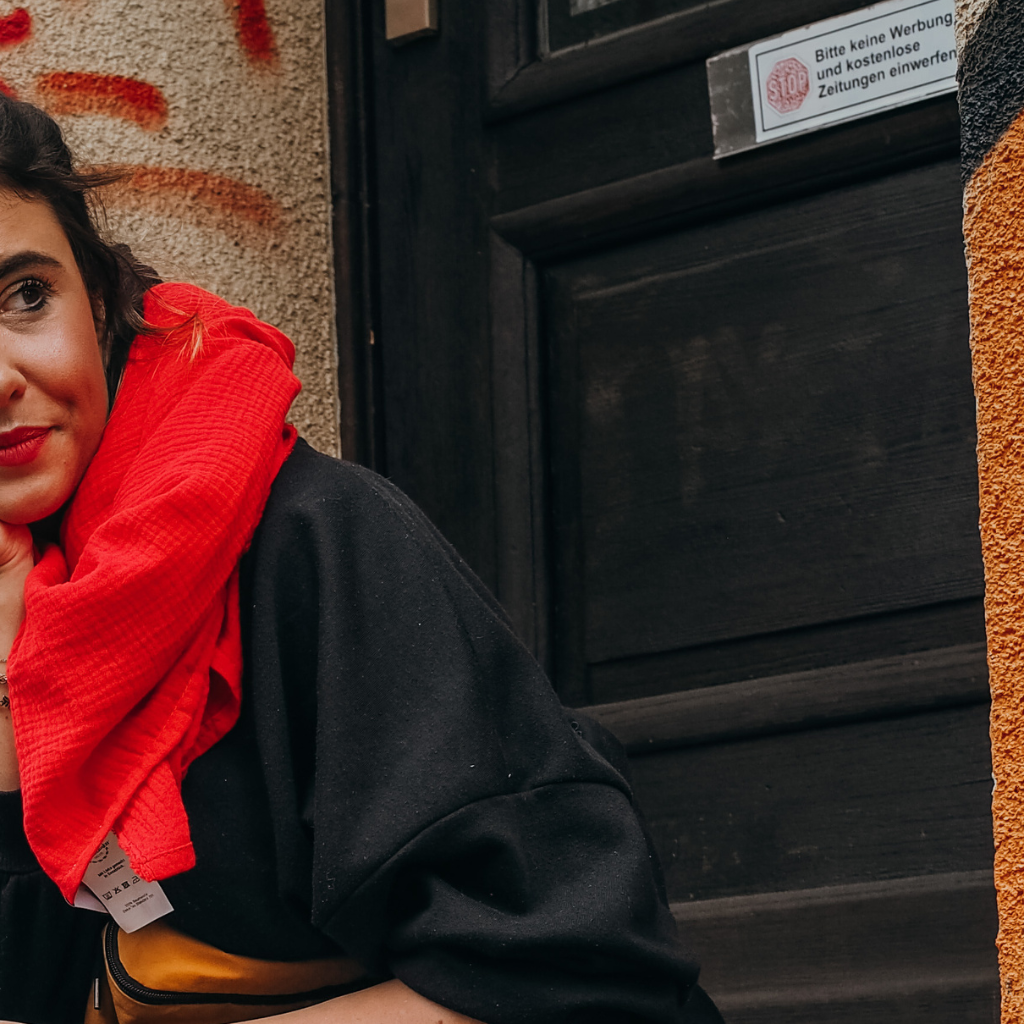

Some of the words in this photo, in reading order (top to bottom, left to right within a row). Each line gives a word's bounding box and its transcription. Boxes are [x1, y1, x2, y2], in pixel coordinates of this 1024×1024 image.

[815, 45, 846, 63] Bitte
[850, 33, 886, 52] keine
[889, 13, 953, 40] Werbung
[817, 61, 842, 81] und
[846, 41, 921, 72] kostenlose
[818, 70, 886, 99] Zeitungen
[889, 49, 957, 77] einwerfen
[768, 71, 808, 100] STOP
